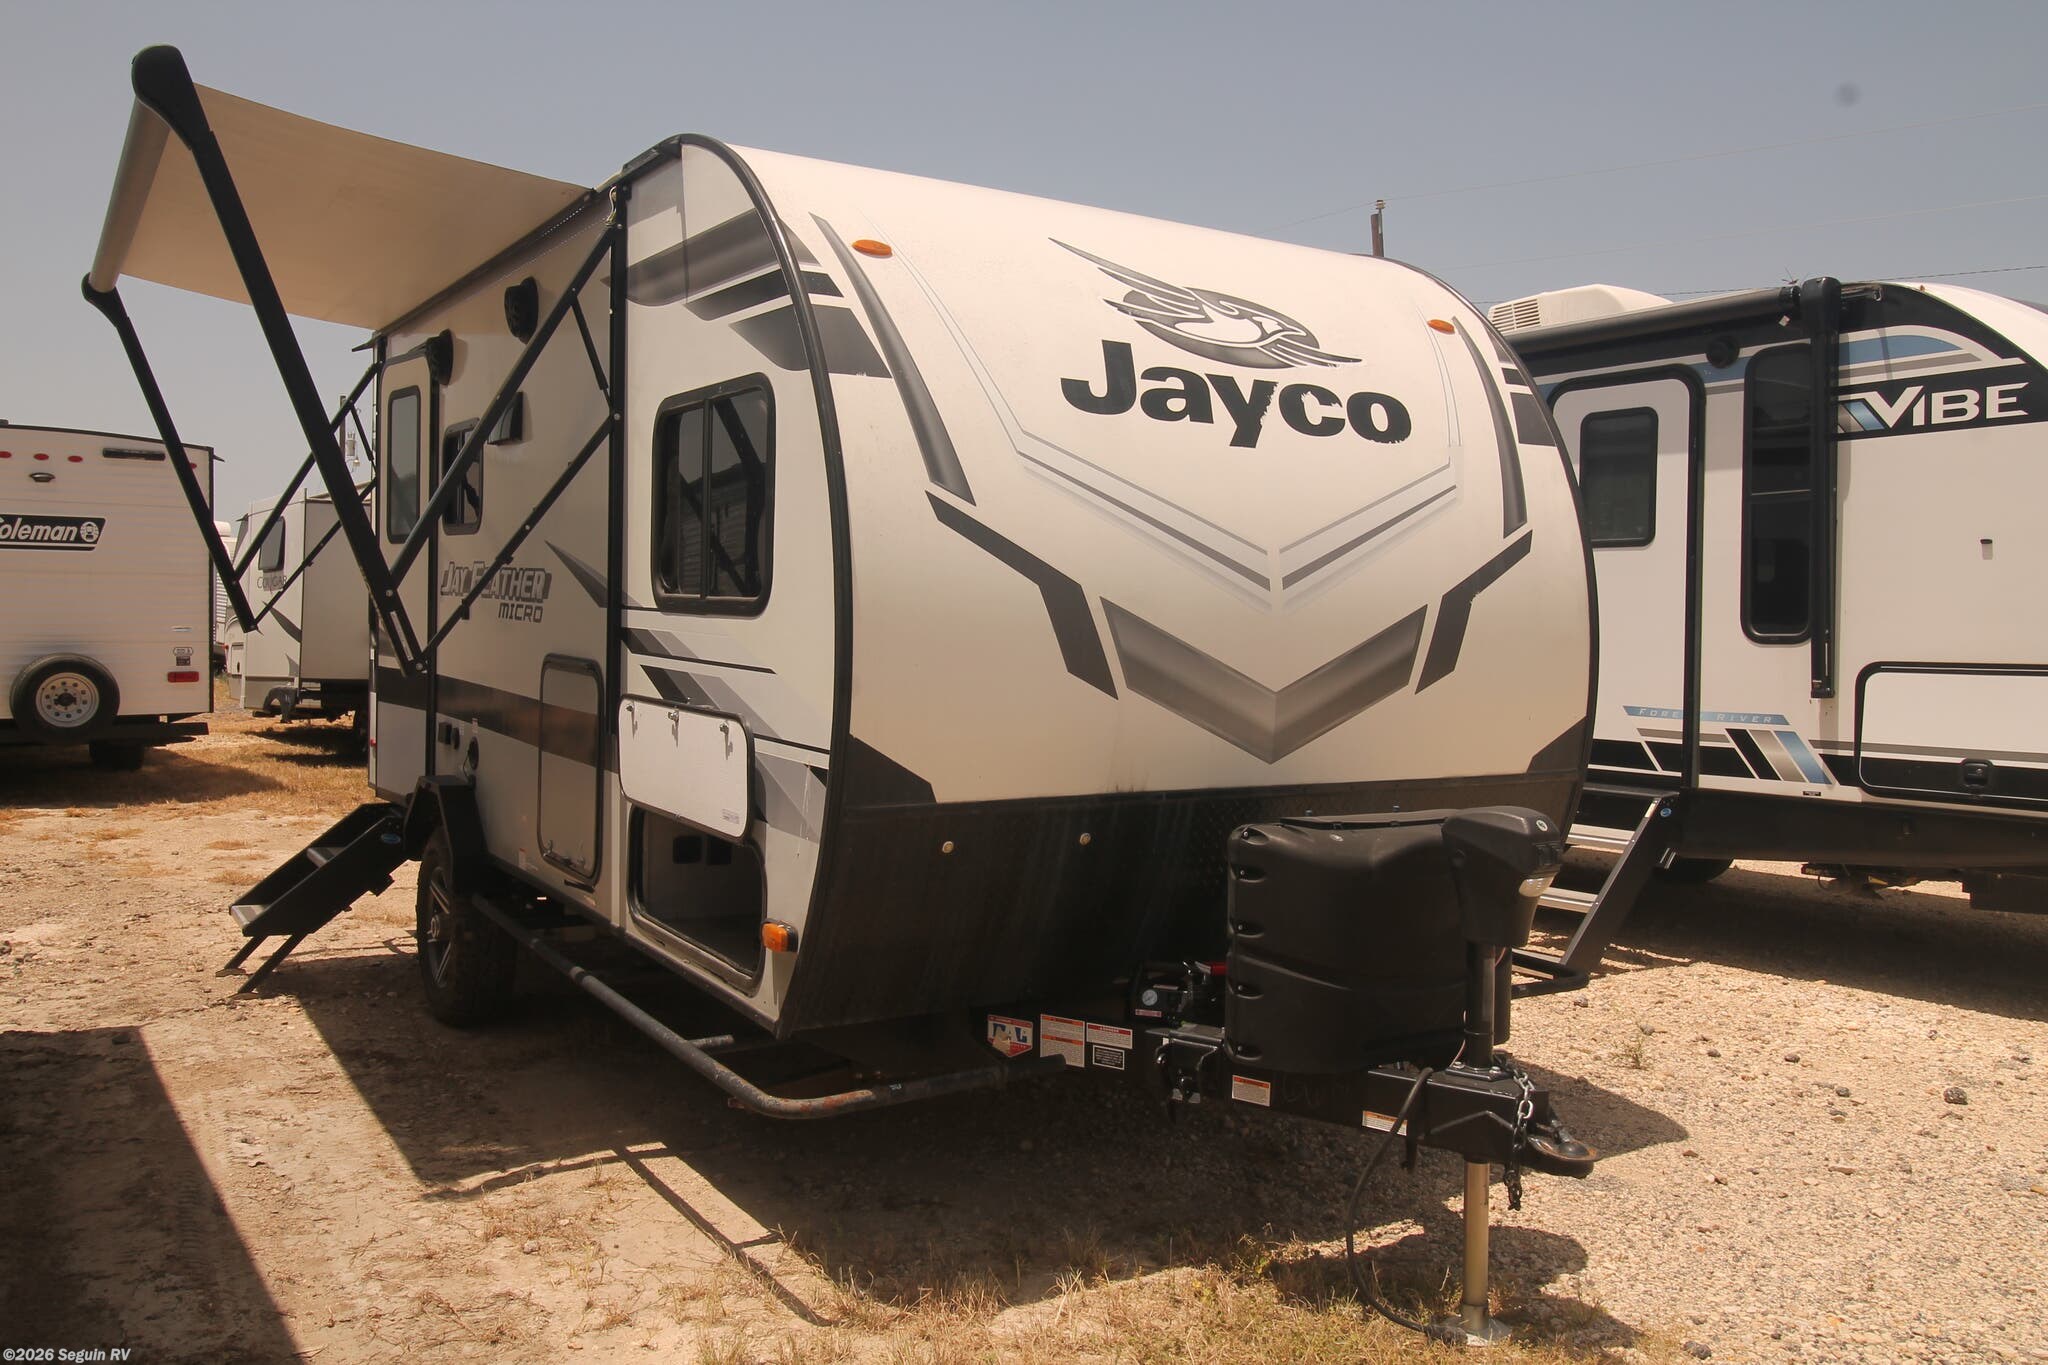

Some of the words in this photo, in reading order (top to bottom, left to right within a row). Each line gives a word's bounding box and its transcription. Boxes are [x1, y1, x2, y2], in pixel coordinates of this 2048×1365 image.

[1060, 339, 1412, 449] Jayco
[1858, 381, 2030, 429] VIBE
[0, 517, 78, 541] oleman
[440, 561, 472, 596] JAY
[497, 602, 544, 623] MICRO
[1639, 708, 1690, 719] FORE
[1716, 713, 1772, 724] RIVER
